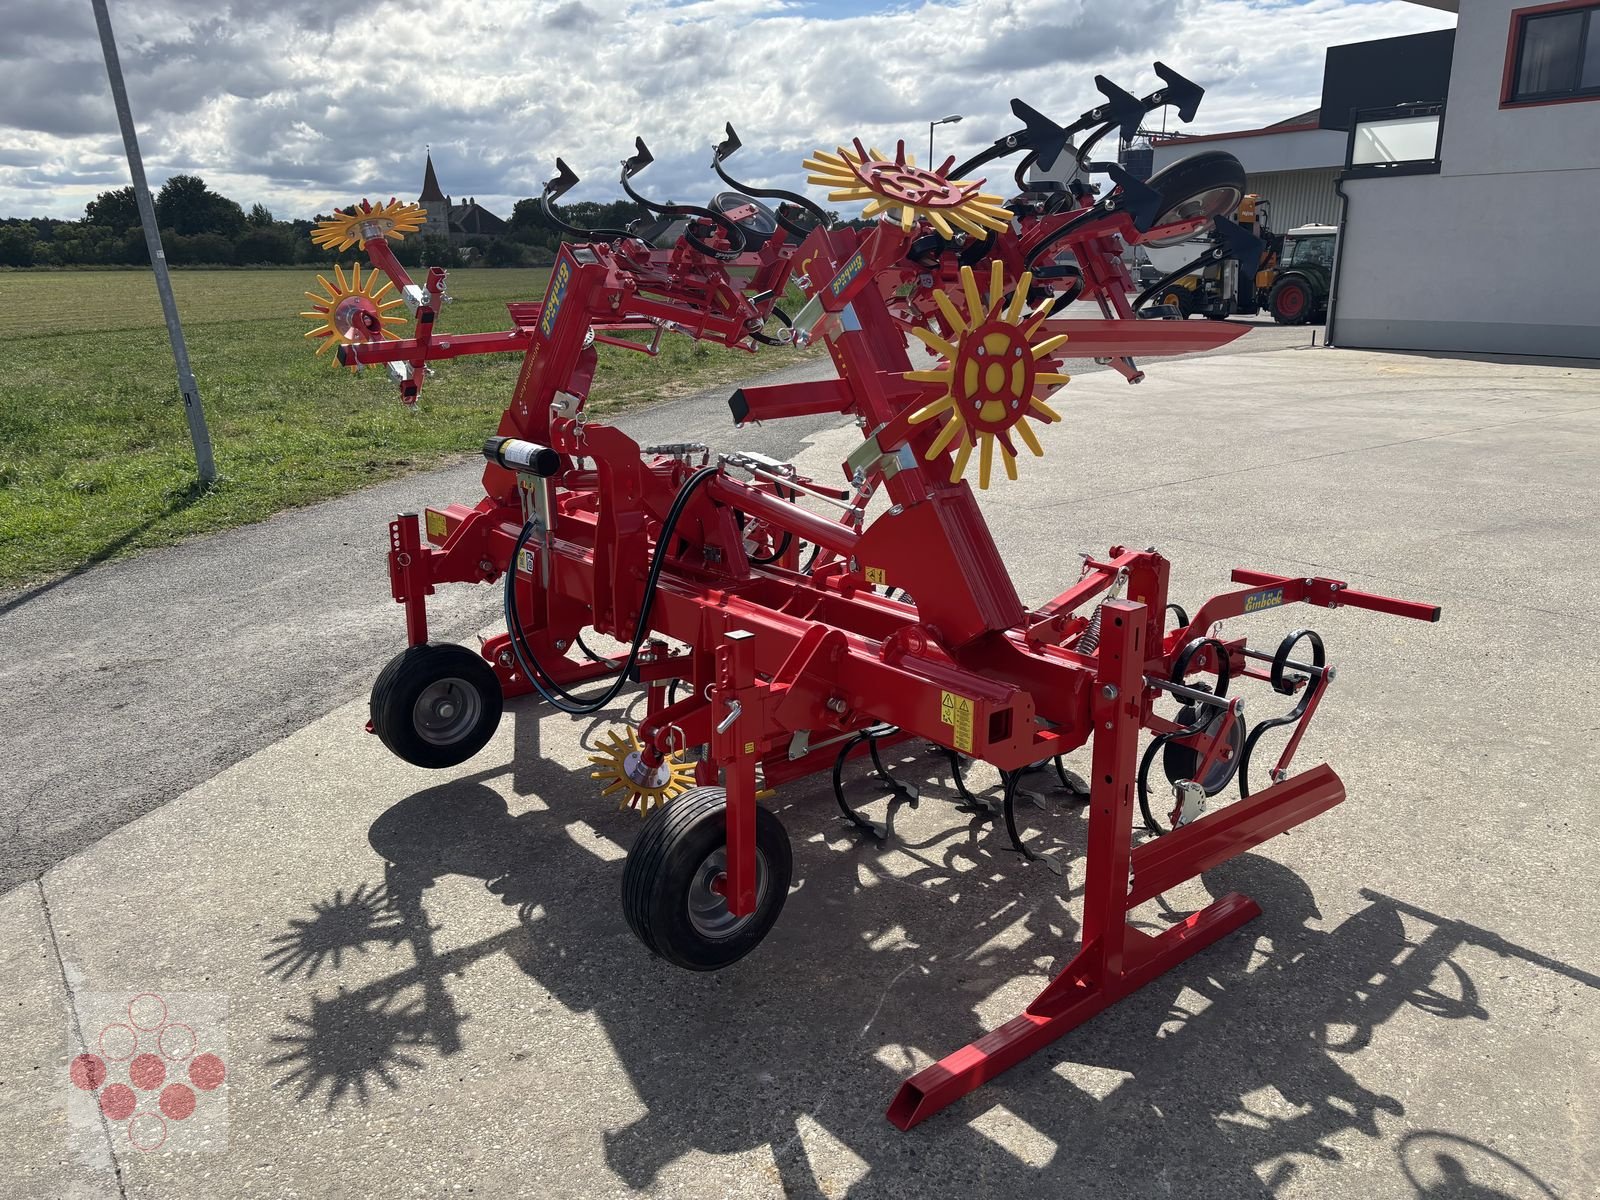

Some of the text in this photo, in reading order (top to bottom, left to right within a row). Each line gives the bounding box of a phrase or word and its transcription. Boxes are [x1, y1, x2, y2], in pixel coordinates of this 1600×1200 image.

[833, 255, 863, 295] Einböck
[541, 261, 569, 336] Einböck
[1245, 589, 1283, 612] Einböck
